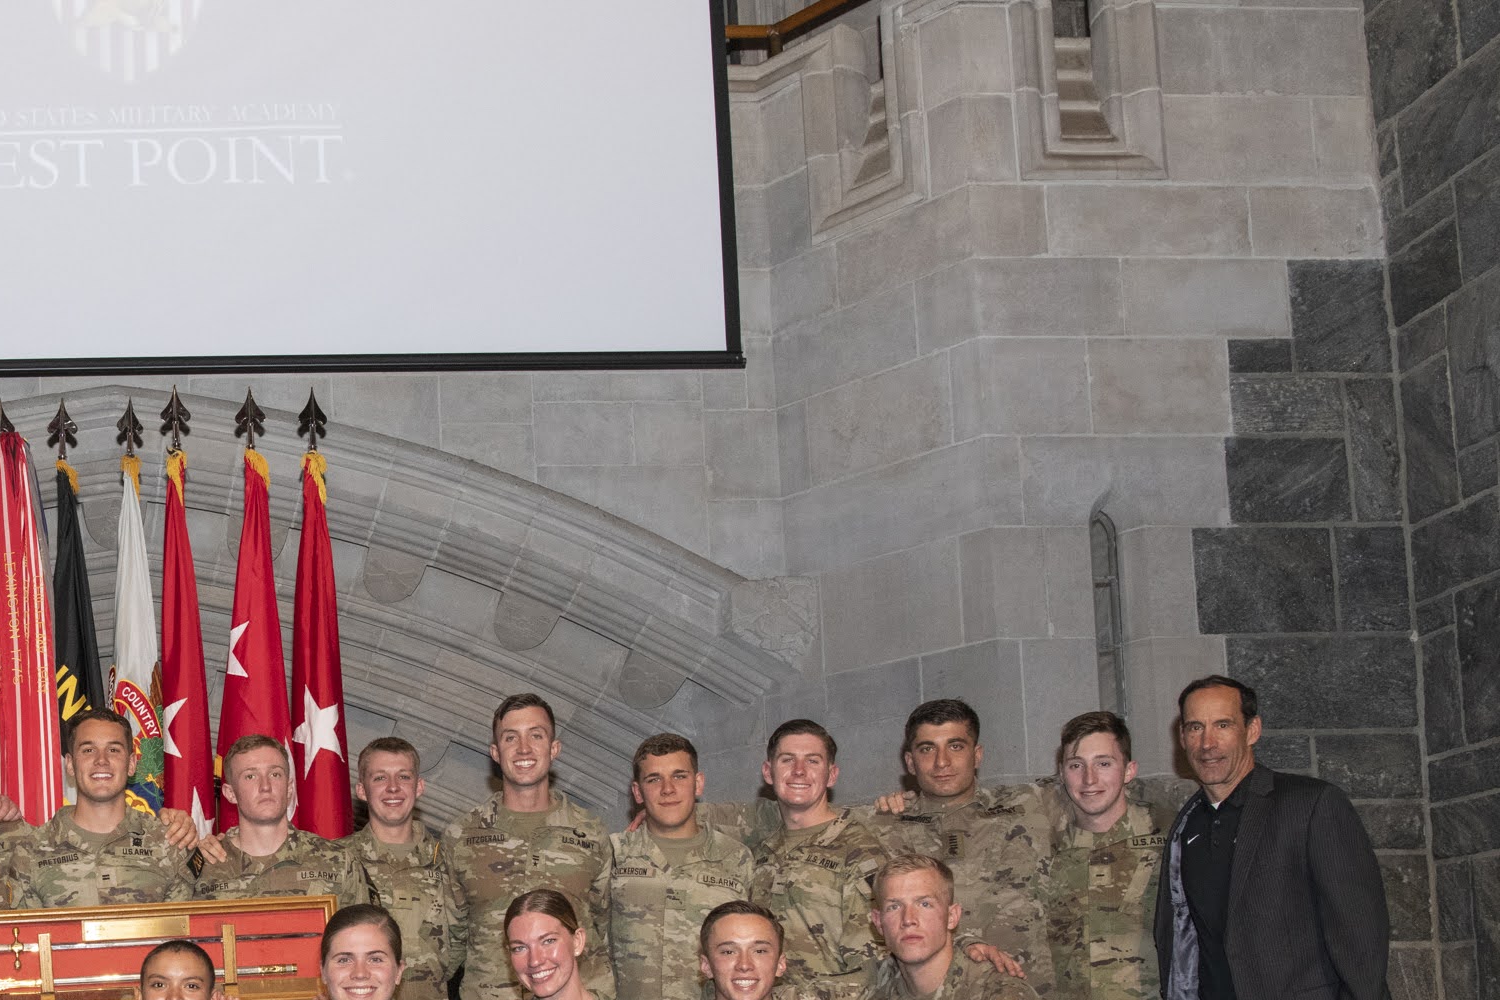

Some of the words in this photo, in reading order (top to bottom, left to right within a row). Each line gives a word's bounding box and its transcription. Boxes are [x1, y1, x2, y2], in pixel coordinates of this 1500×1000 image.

[108, 104, 213, 125] MILITARY
[228, 102, 340, 122] ACADEMY
[124, 135, 343, 187] POINT
[3, 551, 20, 639] LEXINGTON
[121, 686, 160, 737] COUNTRY
[466, 834, 505, 845] FITZGERALD
[1149, 837, 1167, 845] AR
[38, 853, 79, 868] PRETORIUS
[201, 882, 229, 894] COOPER
